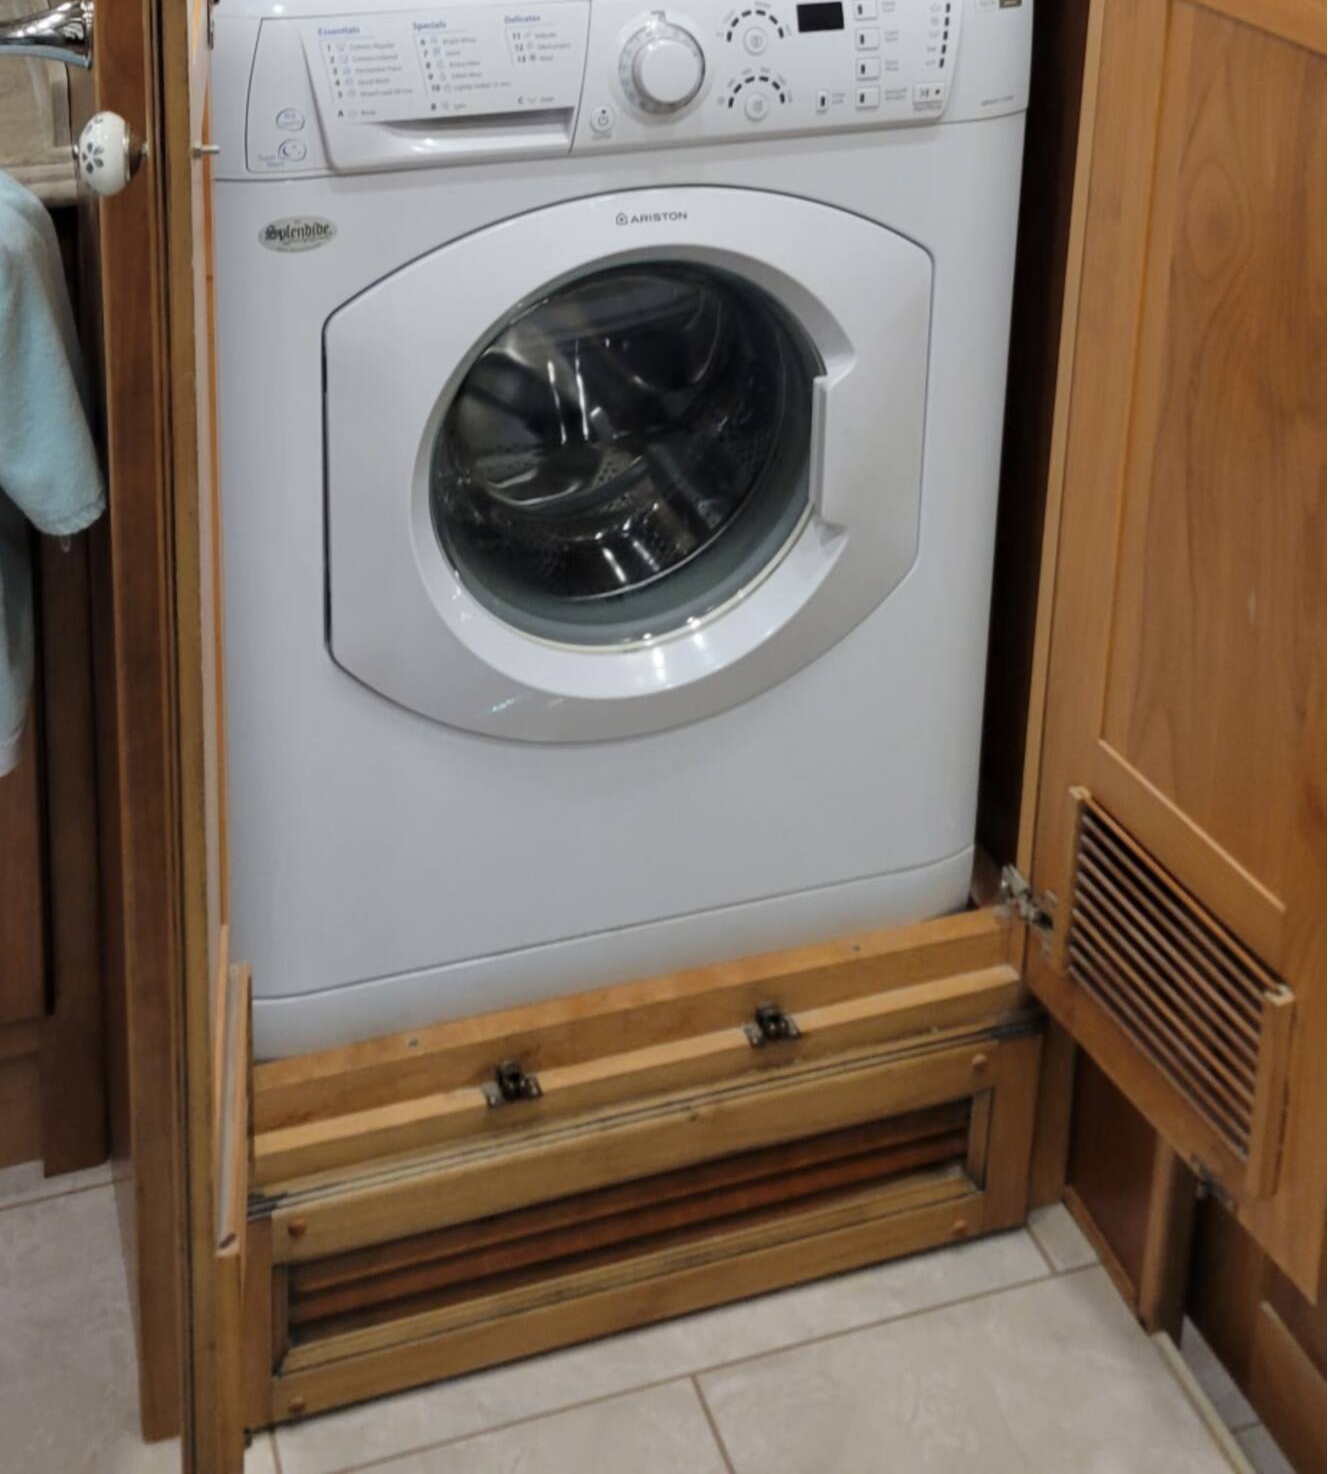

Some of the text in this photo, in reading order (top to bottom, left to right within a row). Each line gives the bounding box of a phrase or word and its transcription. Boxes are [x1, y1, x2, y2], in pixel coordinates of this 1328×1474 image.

[318, 26, 361, 37] Essentials
[412, 21, 447, 32] Specials
[337, 109, 345, 118] A
[630, 210, 687, 225] ARISTON
[264, 222, 331, 242] Splendide
